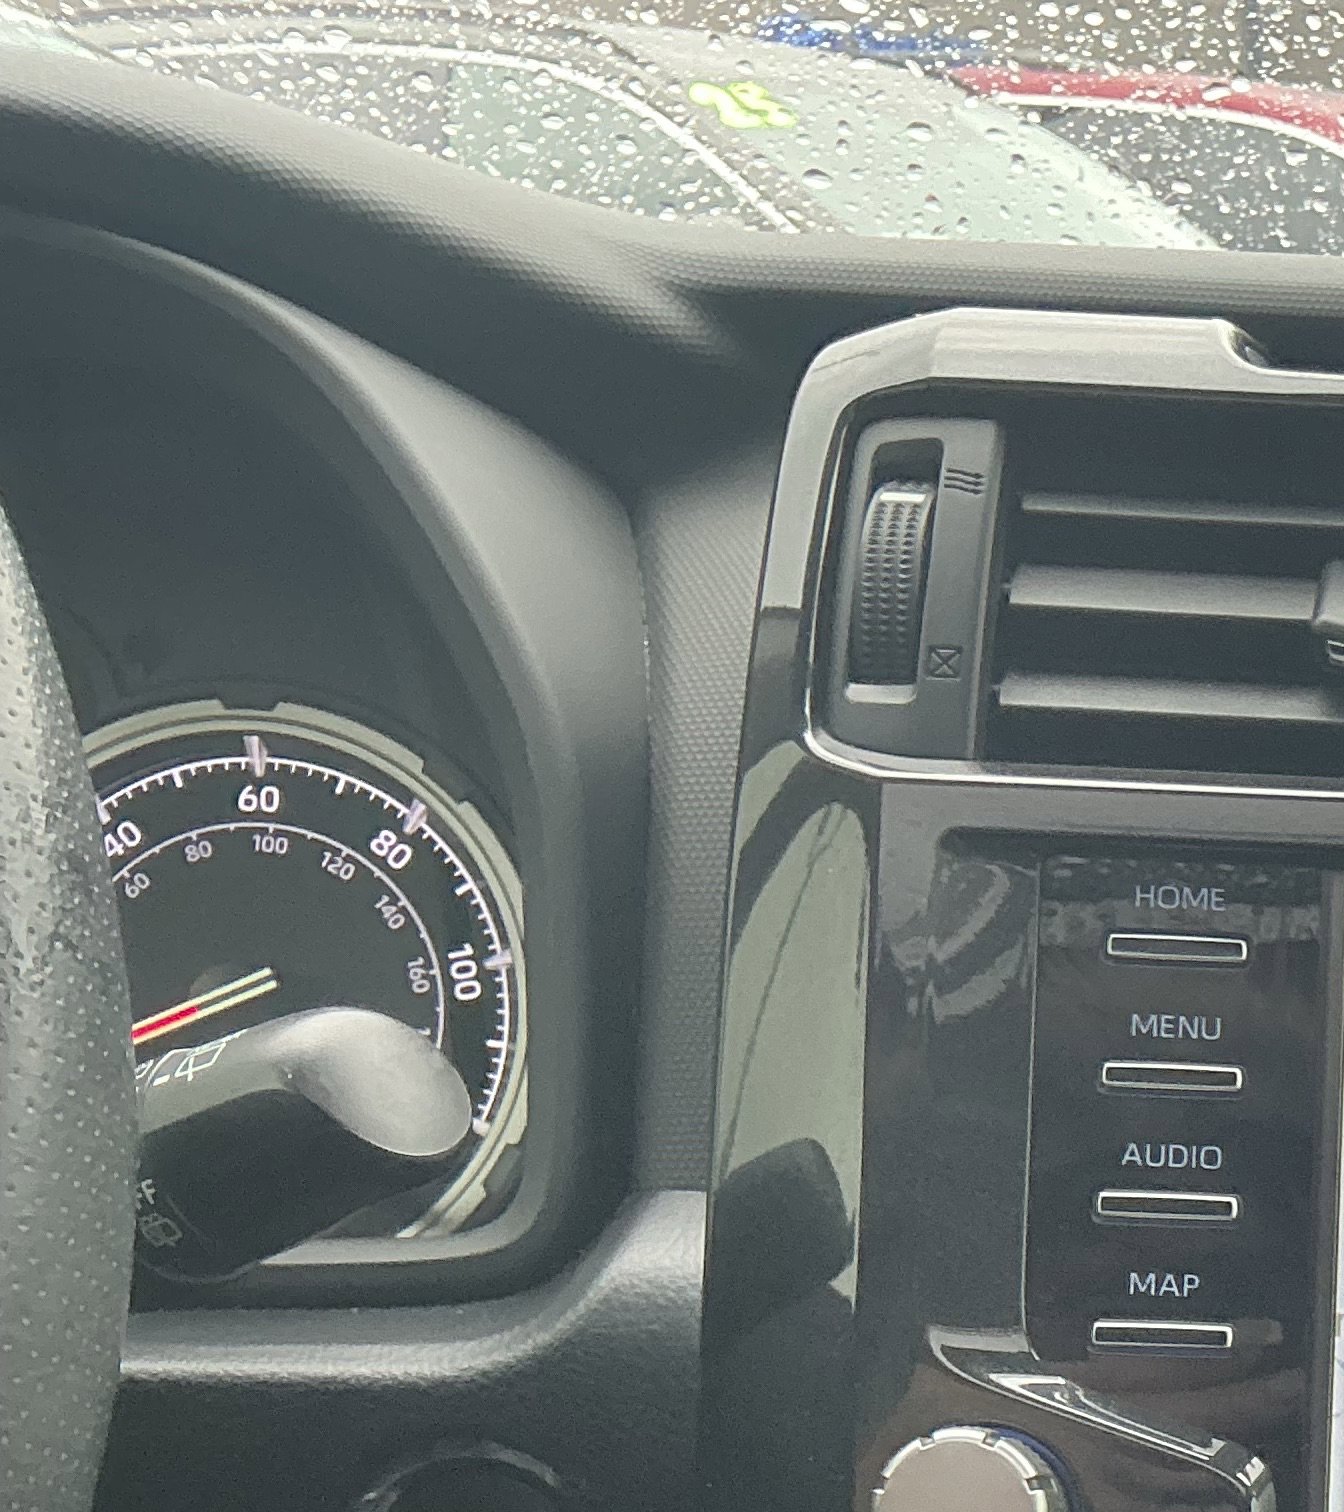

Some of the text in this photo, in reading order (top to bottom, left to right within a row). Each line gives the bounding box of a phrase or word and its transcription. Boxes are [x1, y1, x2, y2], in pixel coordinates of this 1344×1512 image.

[237, 785, 281, 814] 60
[103, 820, 142, 858] 40
[184, 840, 214, 863] 80
[252, 833, 289, 856] 100
[368, 828, 412, 871] 80
[320, 850, 356, 882] 120
[124, 872, 151, 899] 60
[1134, 885, 1226, 912] HOME
[373, 893, 406, 931] 140
[406, 956, 431, 995] 160
[446, 942, 482, 1003] 100
[1130, 1013, 1222, 1041] MENU
[1120, 1143, 1223, 1170] AUDIO
[1127, 1272, 1201, 1297] MAP
